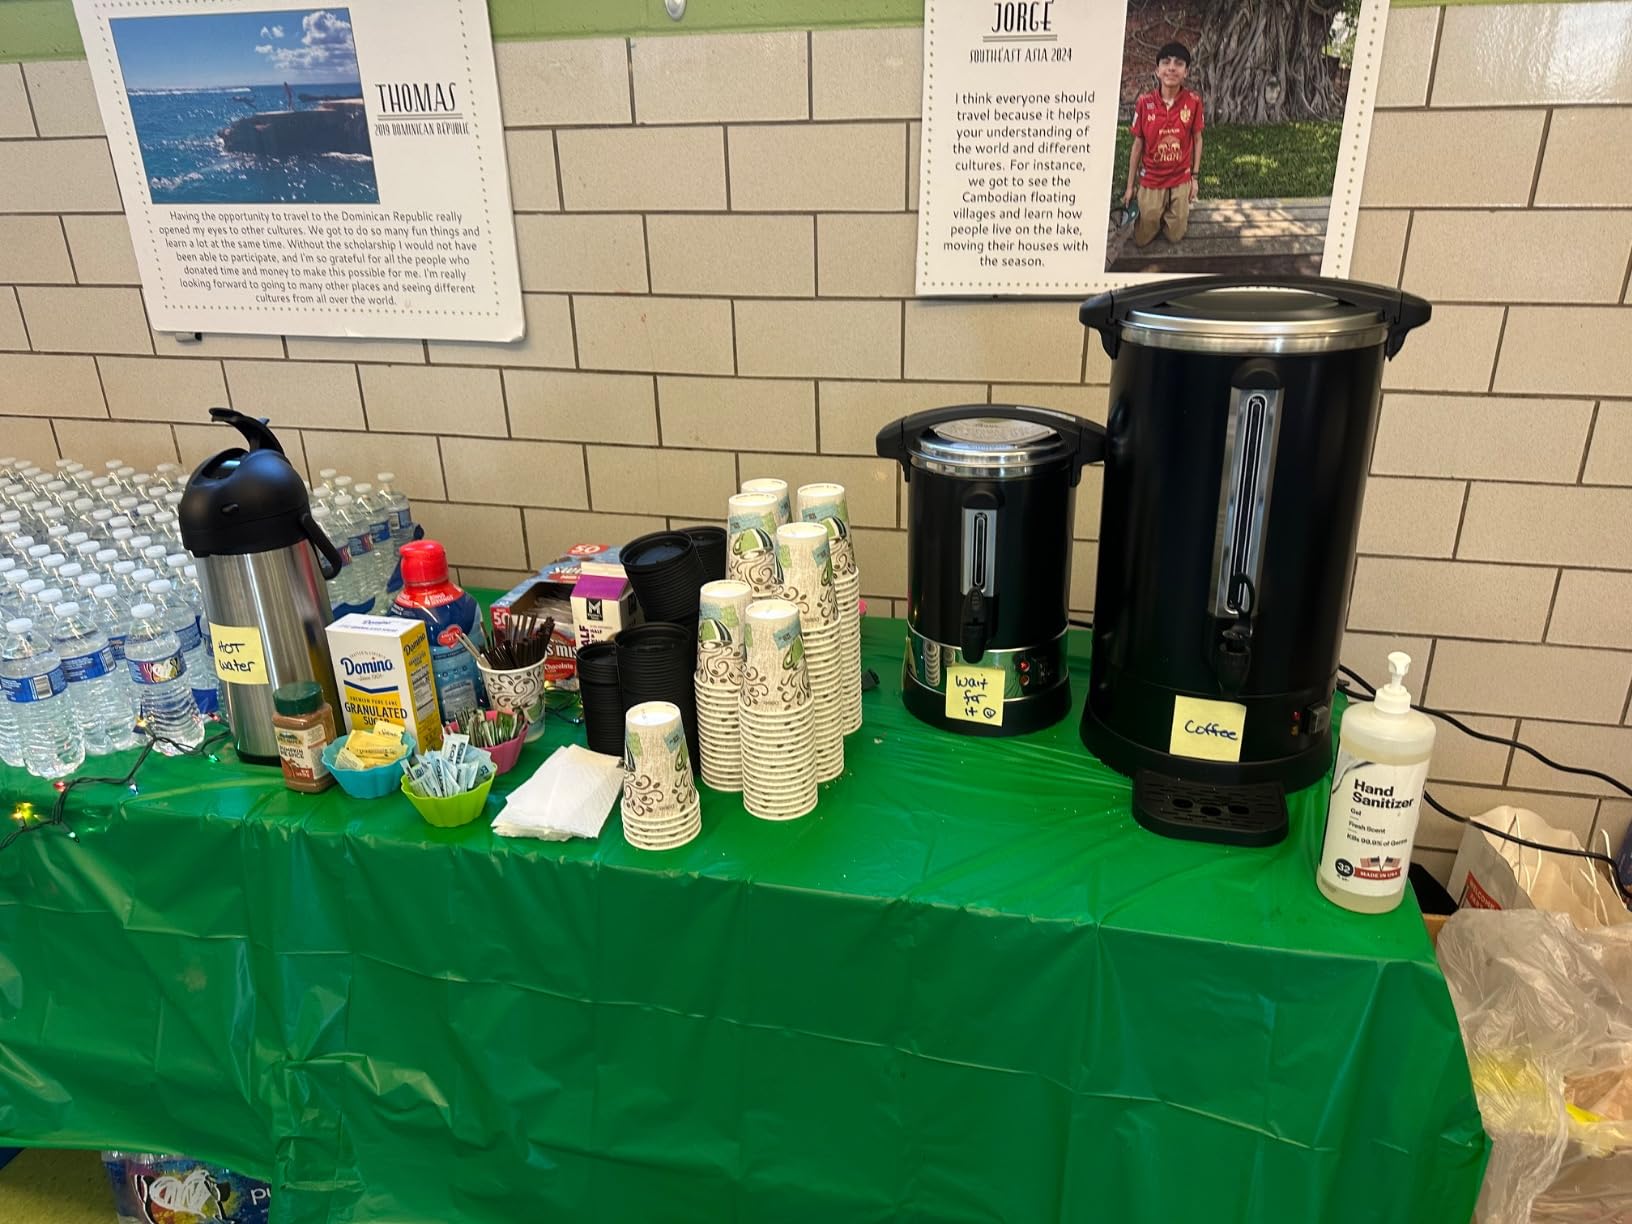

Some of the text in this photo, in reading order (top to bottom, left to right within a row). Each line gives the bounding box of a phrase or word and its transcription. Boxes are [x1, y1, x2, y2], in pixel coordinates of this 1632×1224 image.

[991, 0, 1055, 33] JORGE
[969, 46, 1072, 64] SOUTHEAST ASIA 2024
[375, 82, 456, 112] THOMAS
[962, 92, 991, 104] think
[996, 94, 1050, 106] everyone
[1054, 90, 1094, 103] should
[957, 107, 1090, 122] travel because it helps
[374, 121, 469, 136] 2019 DOMINICAN REPUBLIC
[956, 125, 1089, 140] your understanding of
[953, 141, 1090, 153] the world and different
[955, 158, 1085, 172] cultures. For instance,
[968, 174, 1070, 190] we got to see the
[962, 190, 1075, 206] Cambodian floating
[169, 210, 462, 225] Having the opportunity to travel to the Dominican Republic really
[953, 207, 1082, 222] villages and learn how
[158, 224, 479, 238] opened my eyes to other cultures. We got to do so many fun things and
[950, 223, 1081, 238] people live on the lake,
[165, 238, 187, 247] learn
[196, 238, 208, 249] lot
[209, 239, 219, 250] at
[220, 238, 235, 248] the
[237, 240, 260, 248] same
[262, 238, 285, 248] time.
[286, 239, 324, 249] Without
[326, 239, 341, 250] the
[344, 239, 396, 253] scholarship
[404, 240, 434, 250] would
[436, 241, 452, 250] not
[454, 240, 476, 250] have
[943, 239, 1088, 254] moving their houses with
[176, 251, 469, 267] been able to participate, and I'm so grateful for all the people who
[980, 254, 1044, 266] the season.
[184, 264, 466, 282] donated time and money to make this possible for me. I'm really
[179, 278, 475, 295] looking forward to going to many other places and seeing different
[255, 292, 396, 304] cultures from all over the world.
[571, 544, 601, 554] 50
[589, 600, 601, 614] M
[218, 640, 246, 654] HOT
[340, 657, 393, 676] Domino
[963, 689, 987, 705] for
[344, 701, 408, 719] GRANULATED
[964, 706, 978, 716] it
[1184, 719, 1238, 741] Coffee
[1354, 779, 1394, 797] Hand
[1352, 791, 1414, 809] Sanitizer
[1350, 808, 1362, 816] Gel
[1348, 820, 1386, 834] Fresh Scent
[1346, 832, 1360, 843] Kills
[1383, 838, 1390, 847] of
[1336, 861, 1351, 874] 32
[1360, 870, 1379, 880] MADE
[1380, 871, 1387, 879] IN
